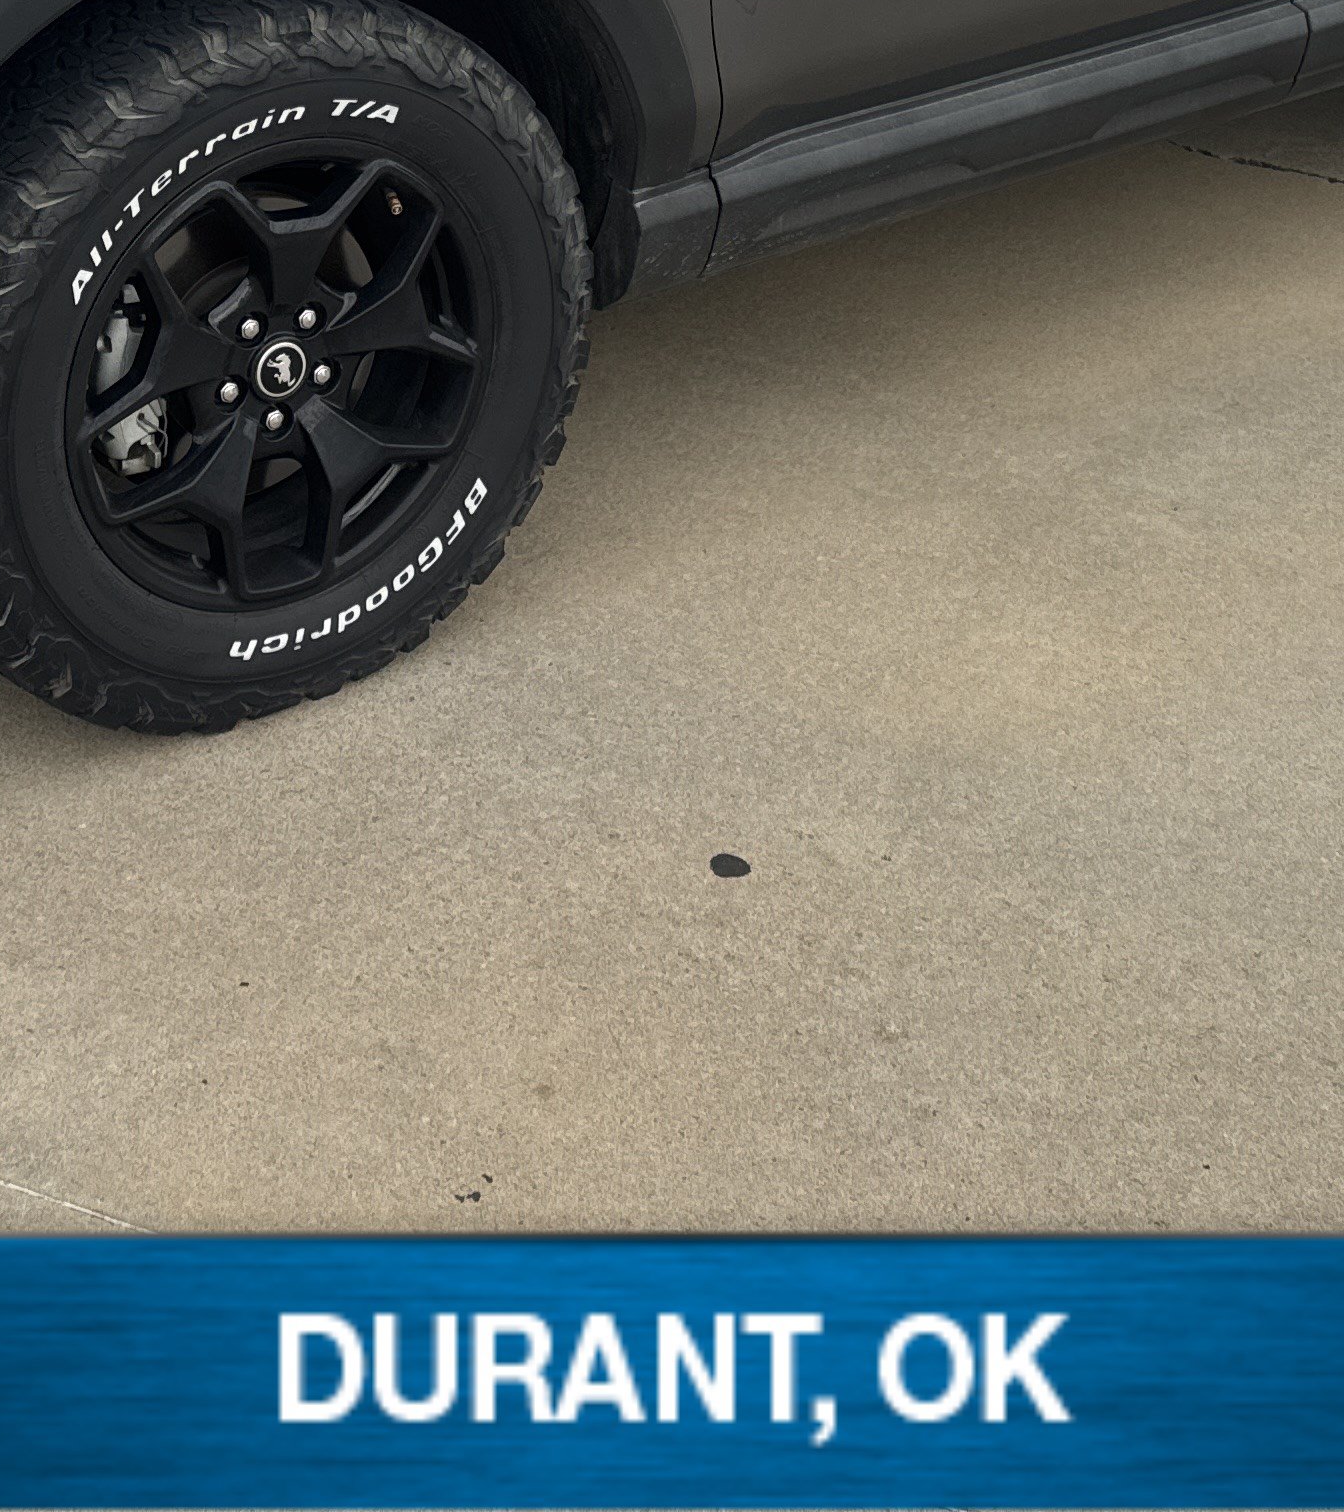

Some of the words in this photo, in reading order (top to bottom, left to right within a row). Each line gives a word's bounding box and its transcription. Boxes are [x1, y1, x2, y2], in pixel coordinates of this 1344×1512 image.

[70, 102, 306, 306] All-Terrain
[330, 98, 401, 125] T/A
[228, 477, 489, 662] BFGoodrich
